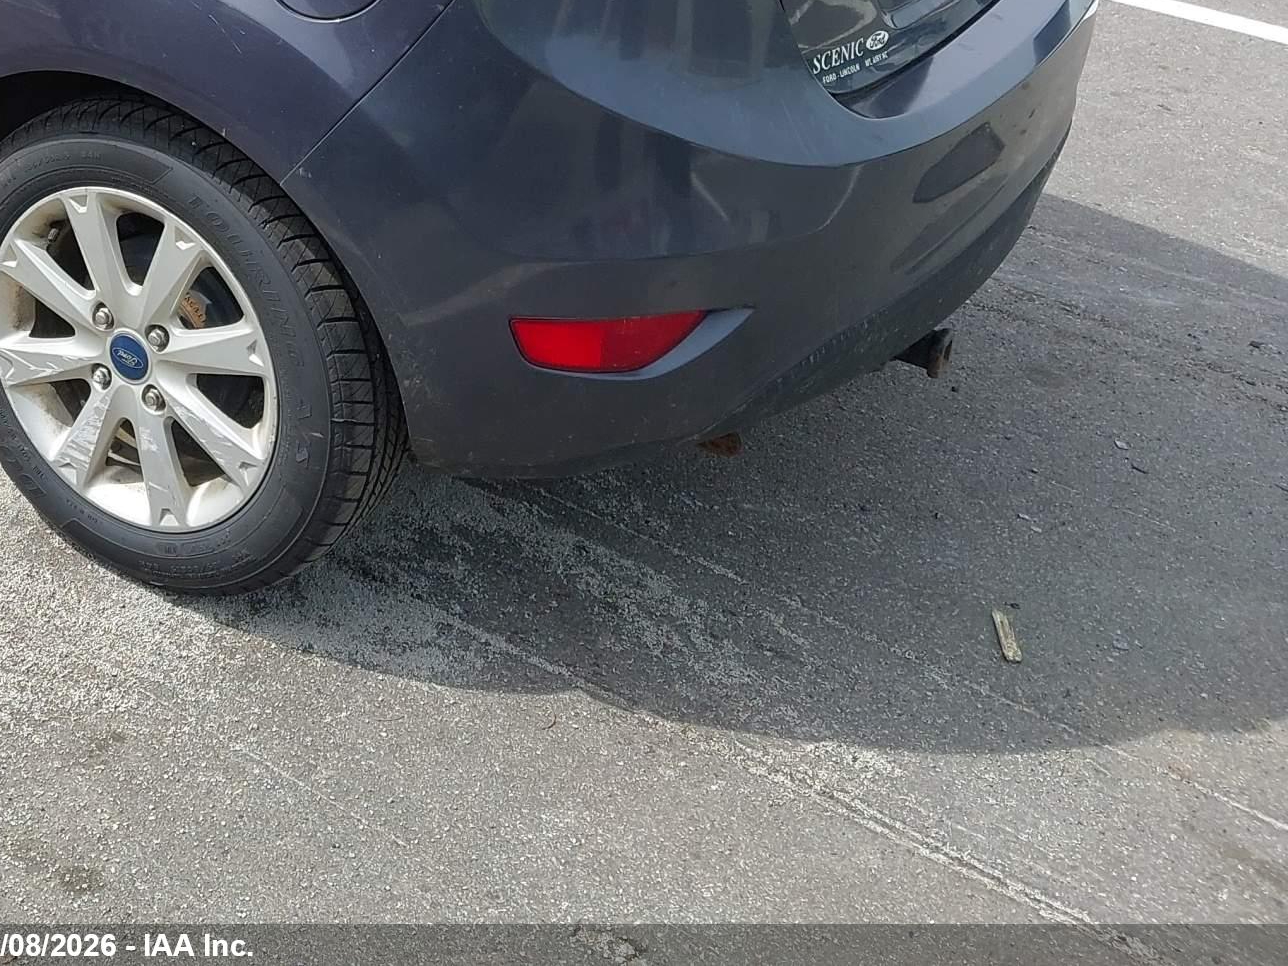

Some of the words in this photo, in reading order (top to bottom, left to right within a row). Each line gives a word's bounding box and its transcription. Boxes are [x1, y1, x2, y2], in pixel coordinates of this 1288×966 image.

[812, 38, 864, 75] SCENIC
[822, 73, 837, 85] FORD
[839, 63, 860, 78] LINCOLN
